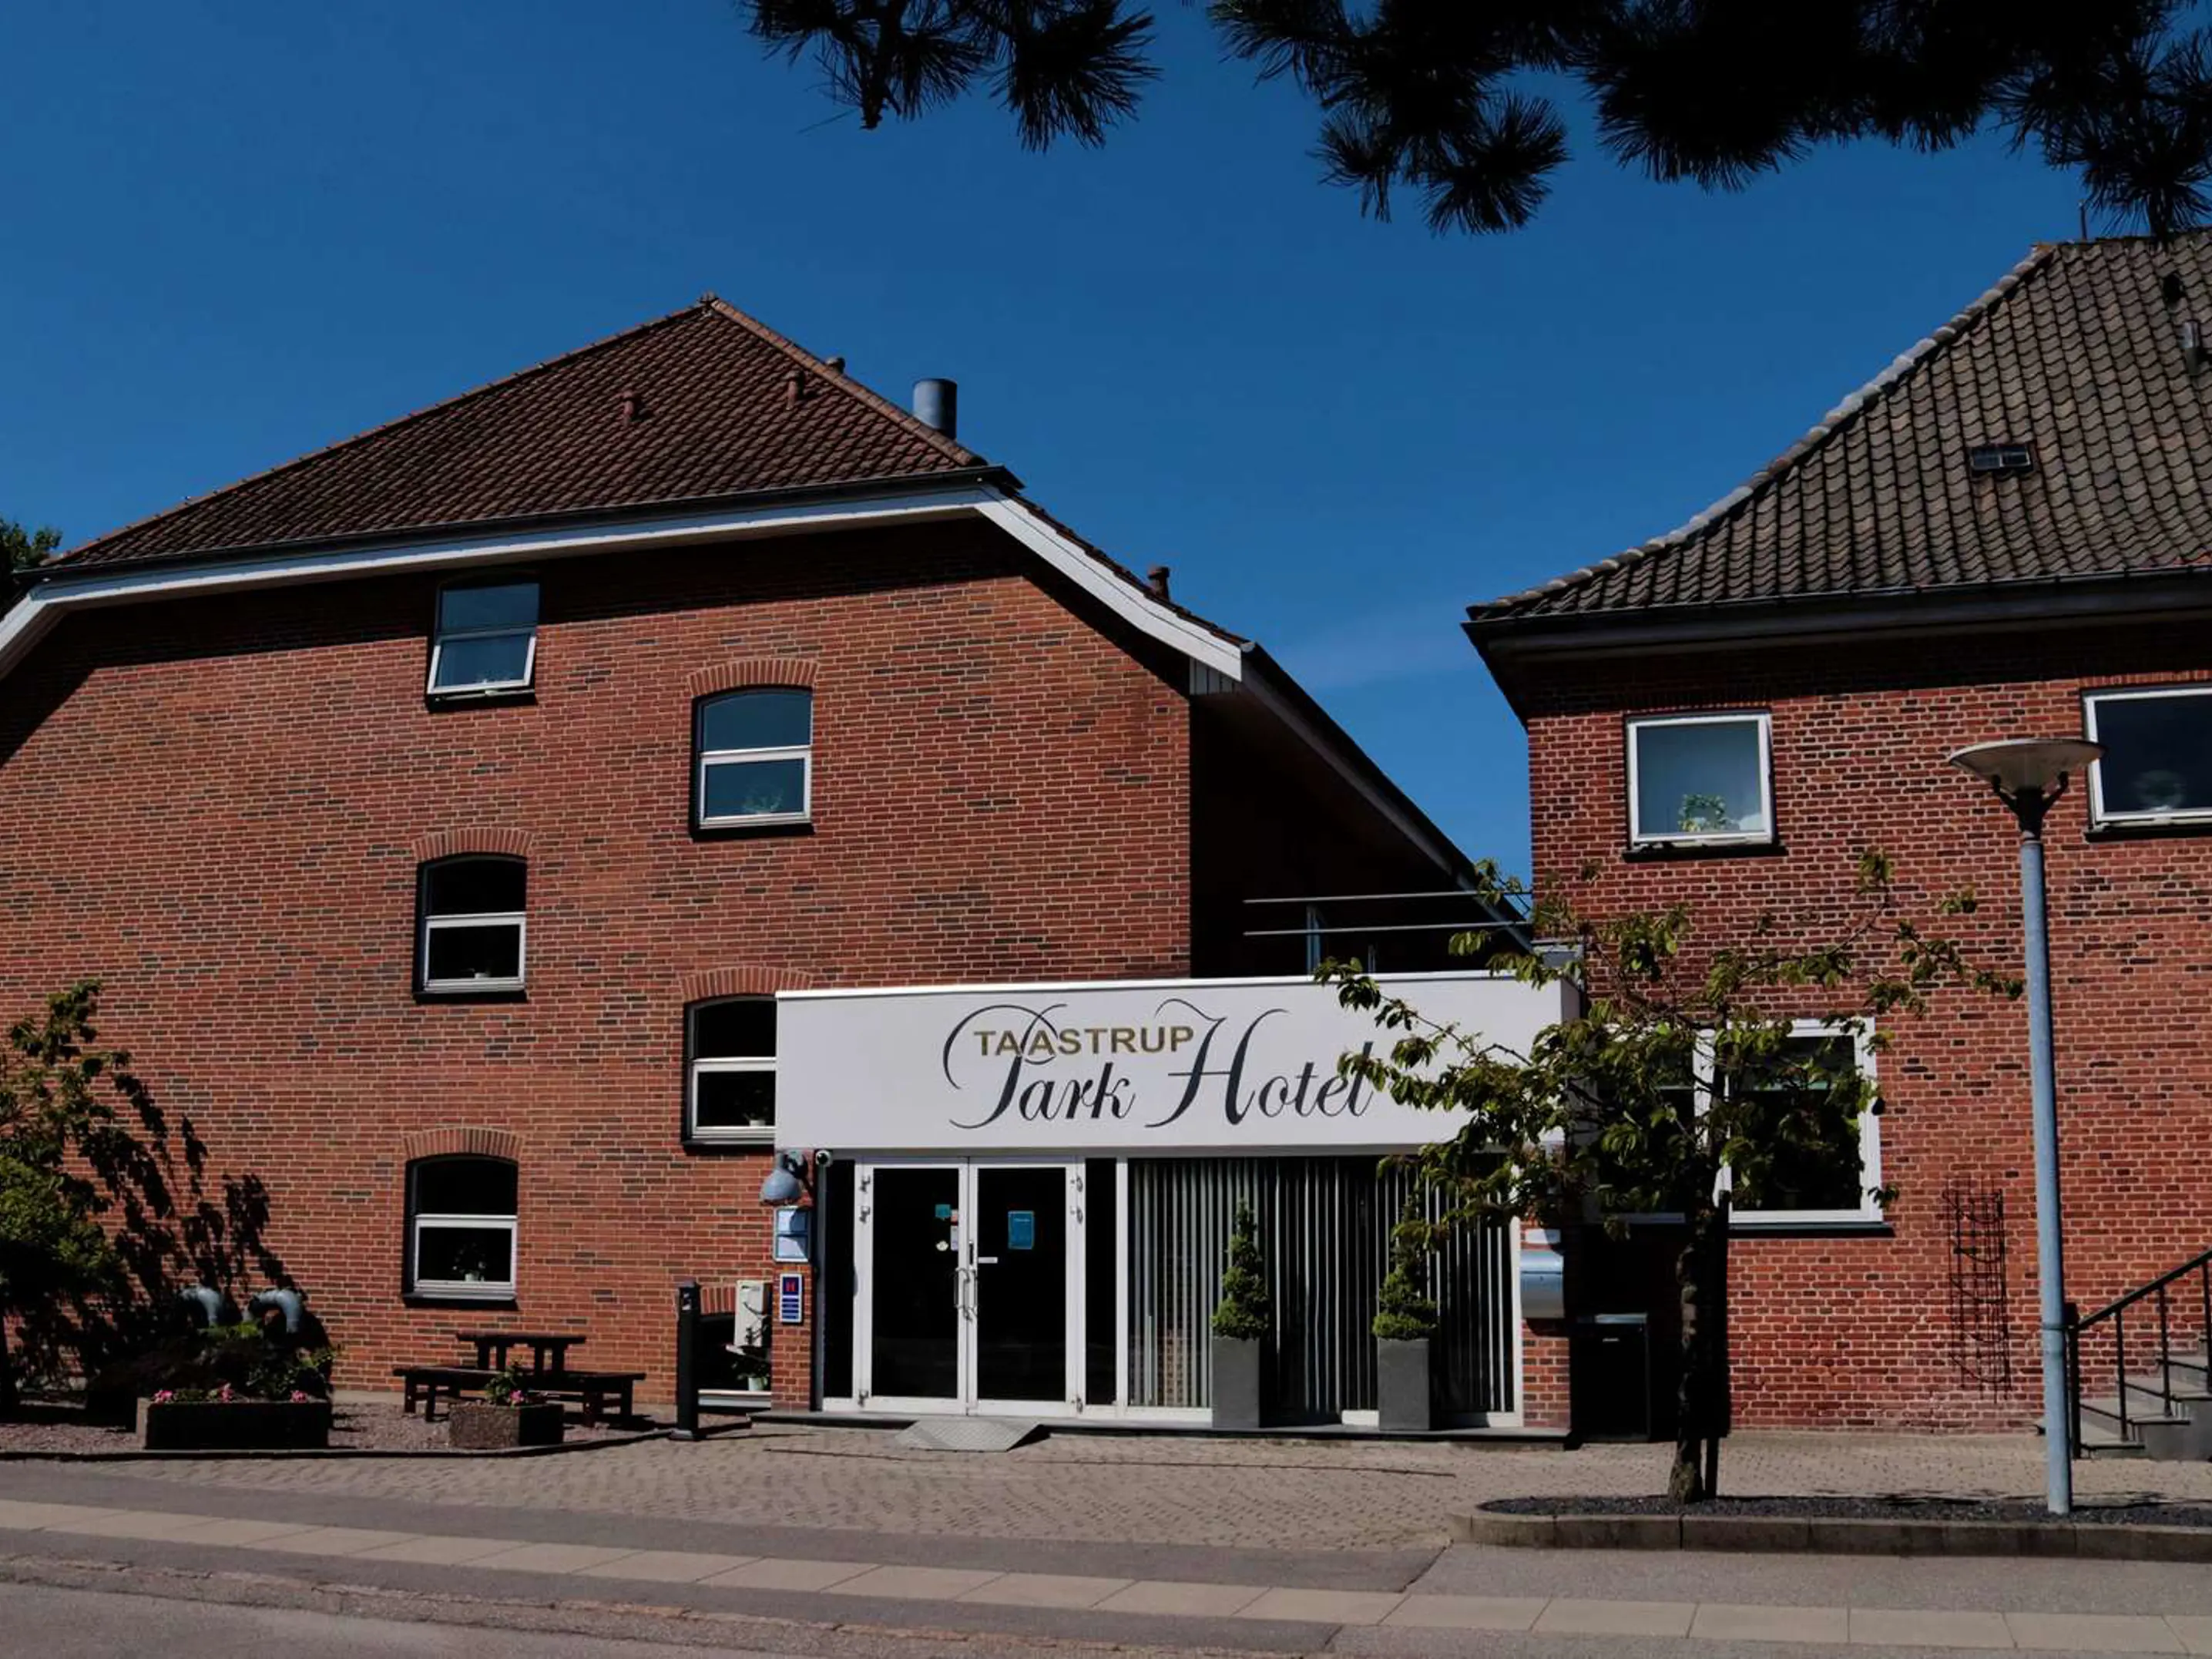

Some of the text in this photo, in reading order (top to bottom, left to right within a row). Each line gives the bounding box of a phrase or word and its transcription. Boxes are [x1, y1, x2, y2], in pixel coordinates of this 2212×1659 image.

[942, 998, 1375, 1130] Park Hotel
[973, 1026, 1194, 1056] TAASTRUP
